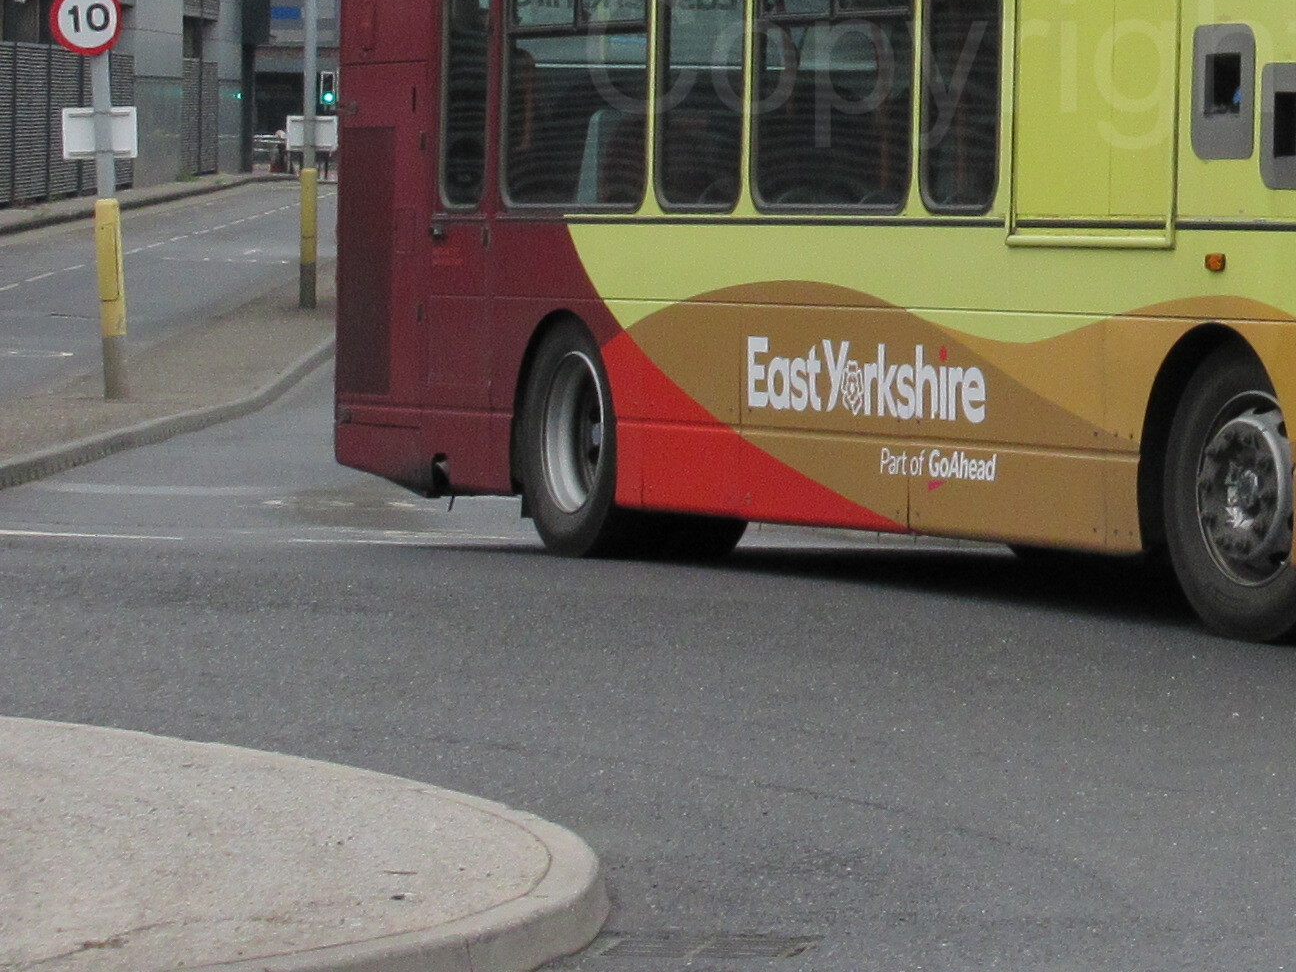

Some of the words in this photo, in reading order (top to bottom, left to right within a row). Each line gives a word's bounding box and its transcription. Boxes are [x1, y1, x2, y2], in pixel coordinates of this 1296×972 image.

[68, 2, 110, 34] 10
[747, 335, 822, 412] East
[821, 338, 986, 423] Yorkshire
[880, 447, 908, 476] Part
[909, 449, 926, 476] of
[928, 449, 998, 481] GoAhead
